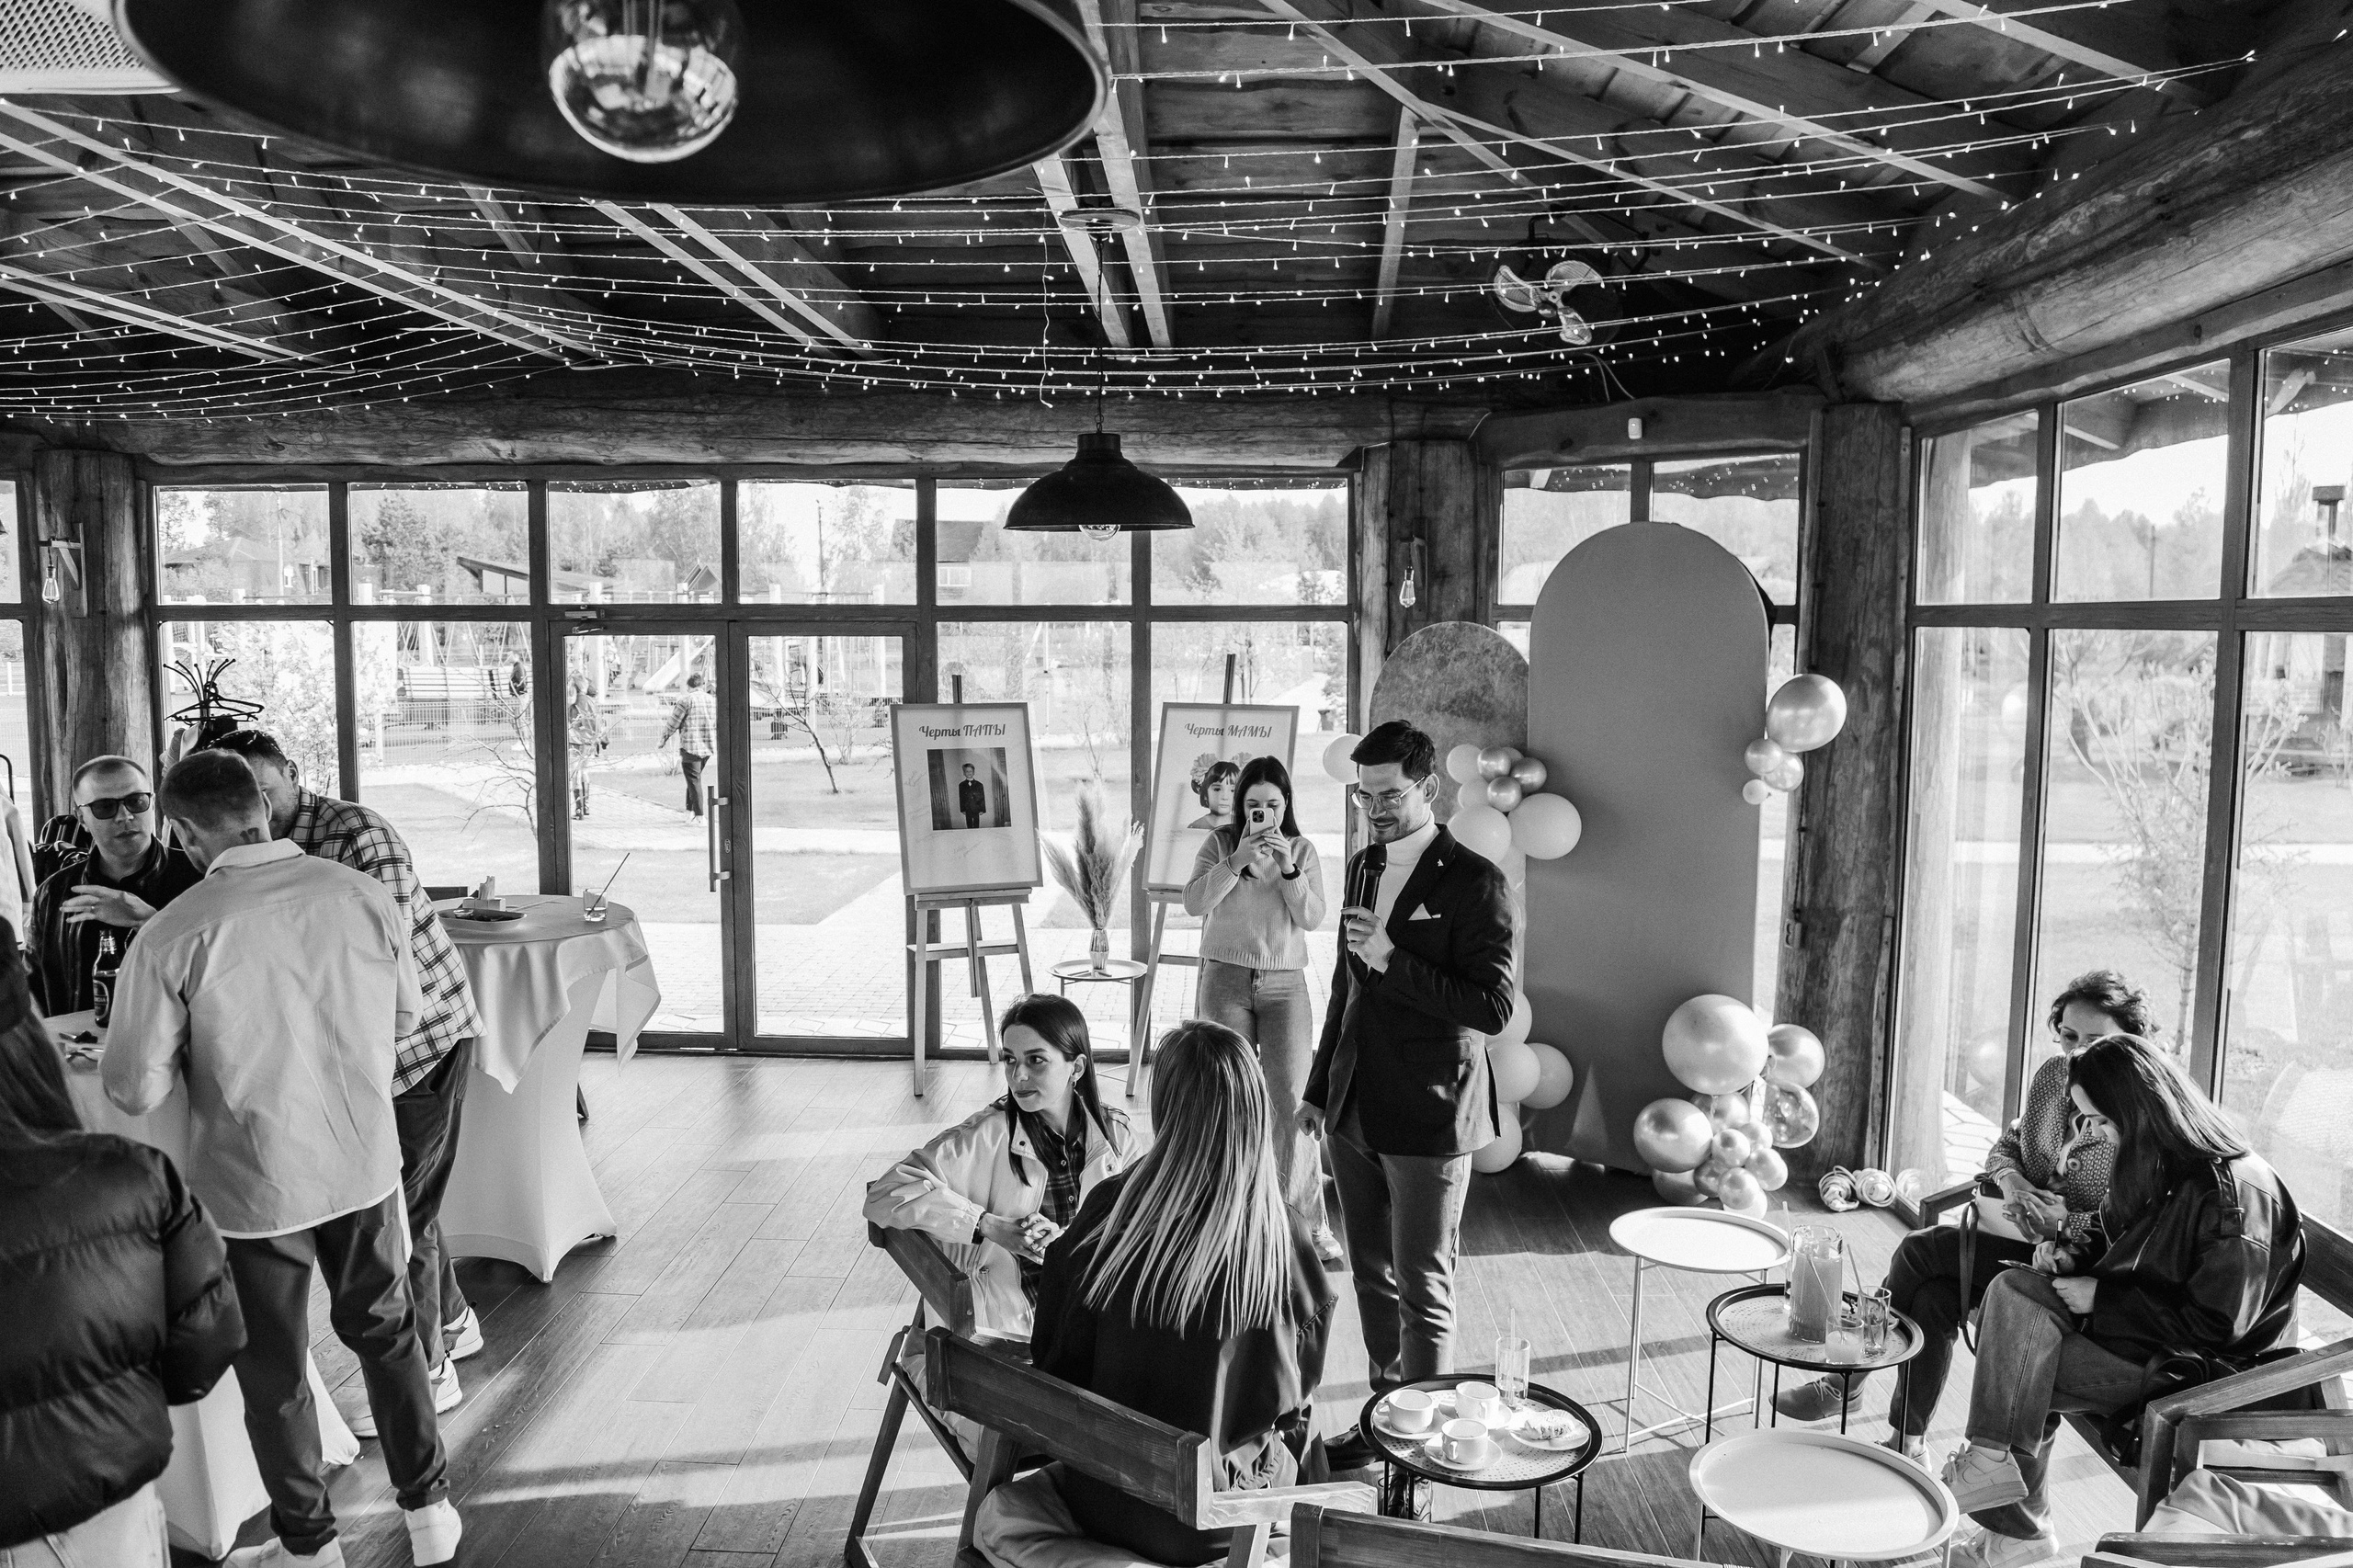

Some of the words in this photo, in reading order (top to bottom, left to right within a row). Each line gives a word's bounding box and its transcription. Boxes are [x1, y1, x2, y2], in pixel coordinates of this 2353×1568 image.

[919, 725, 961, 740] Черты
[962, 724, 1006, 737] ПАПЫ
[1185, 723, 1224, 738] Черты
[1227, 724, 1272, 738] МАМЫ
